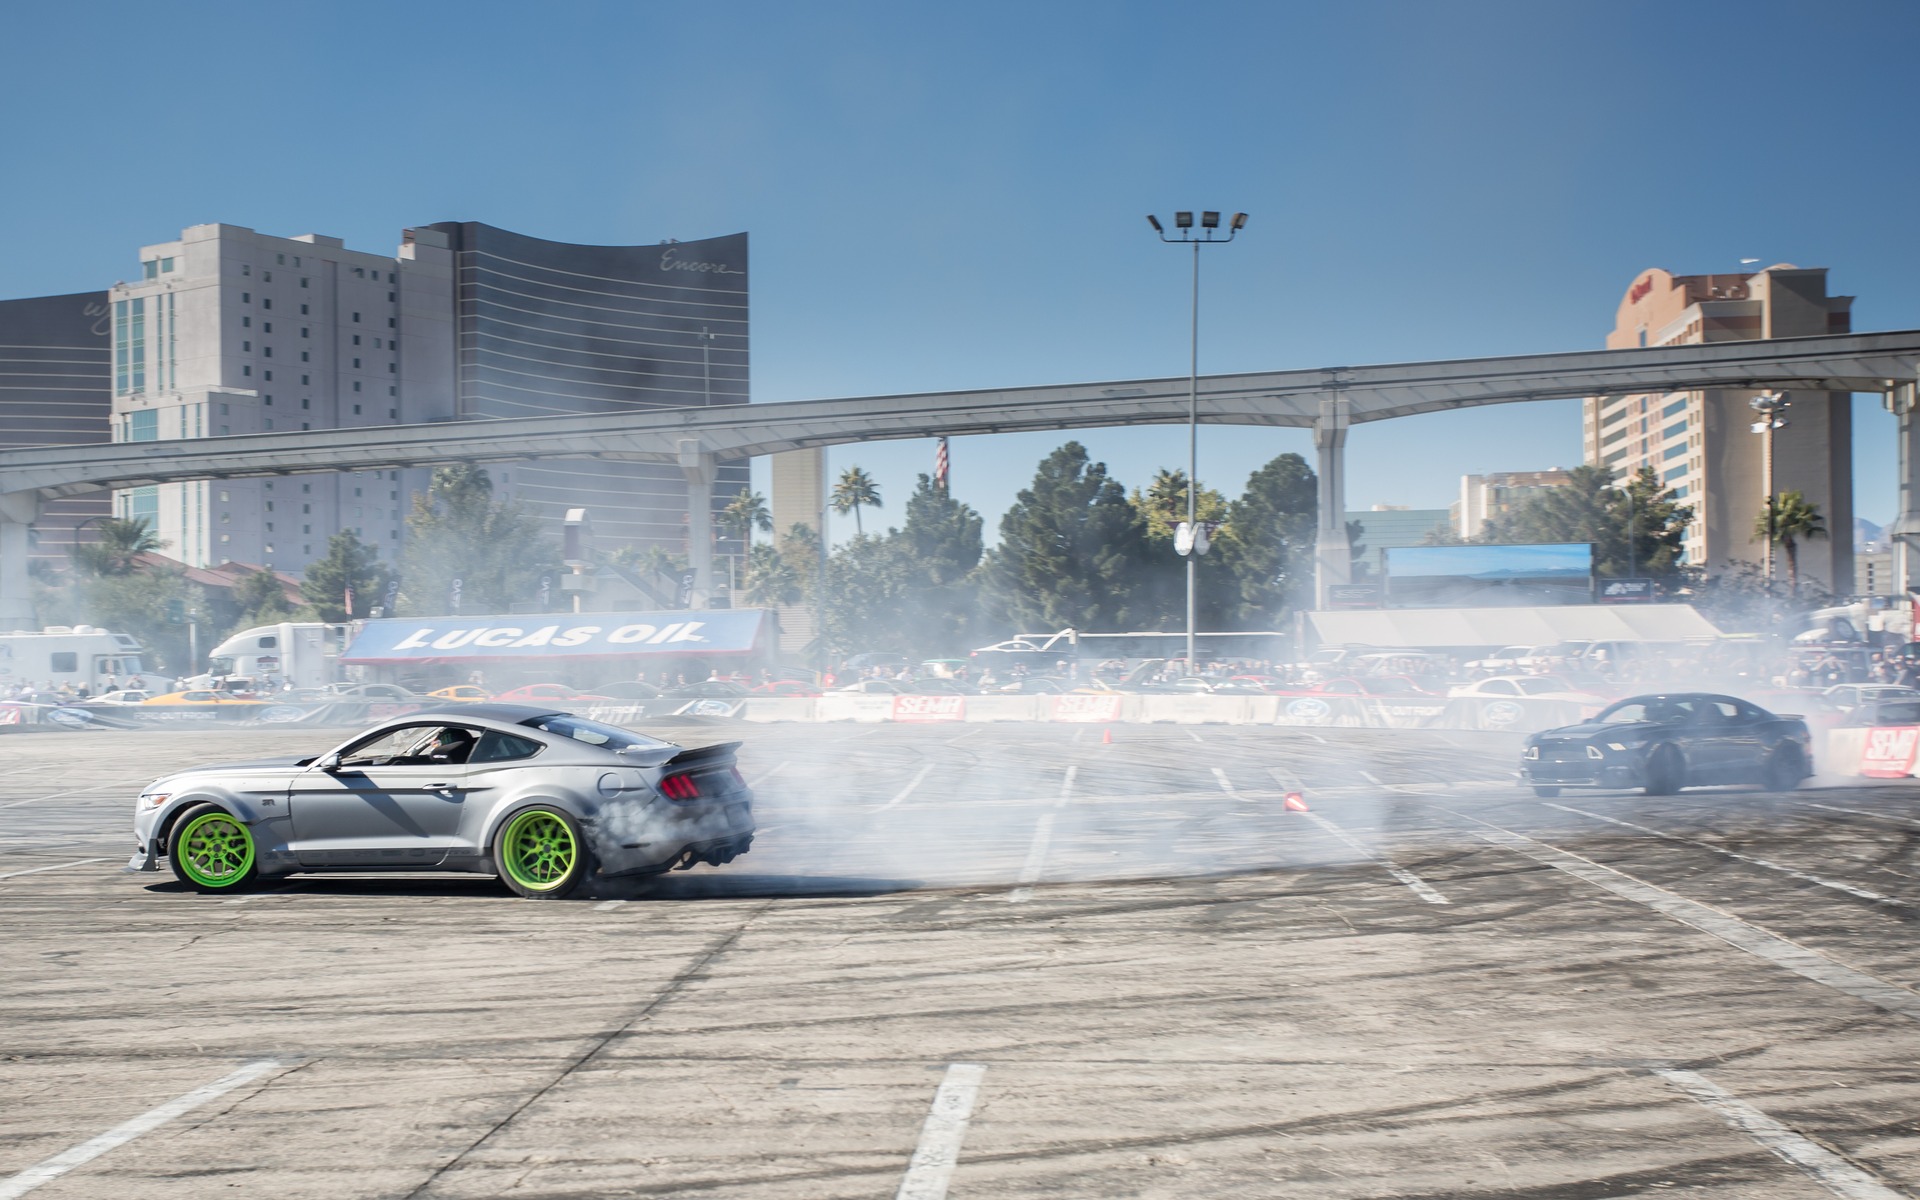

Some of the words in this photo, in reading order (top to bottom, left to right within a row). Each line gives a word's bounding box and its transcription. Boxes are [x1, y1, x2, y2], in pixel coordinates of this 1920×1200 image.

[660, 247, 746, 275] Encore
[392, 624, 602, 651] LUCAS
[606, 621, 707, 645] OIL
[896, 696, 960, 714] SEMA
[1055, 695, 1117, 713] SEMA
[1865, 729, 1918, 760] SEMA
